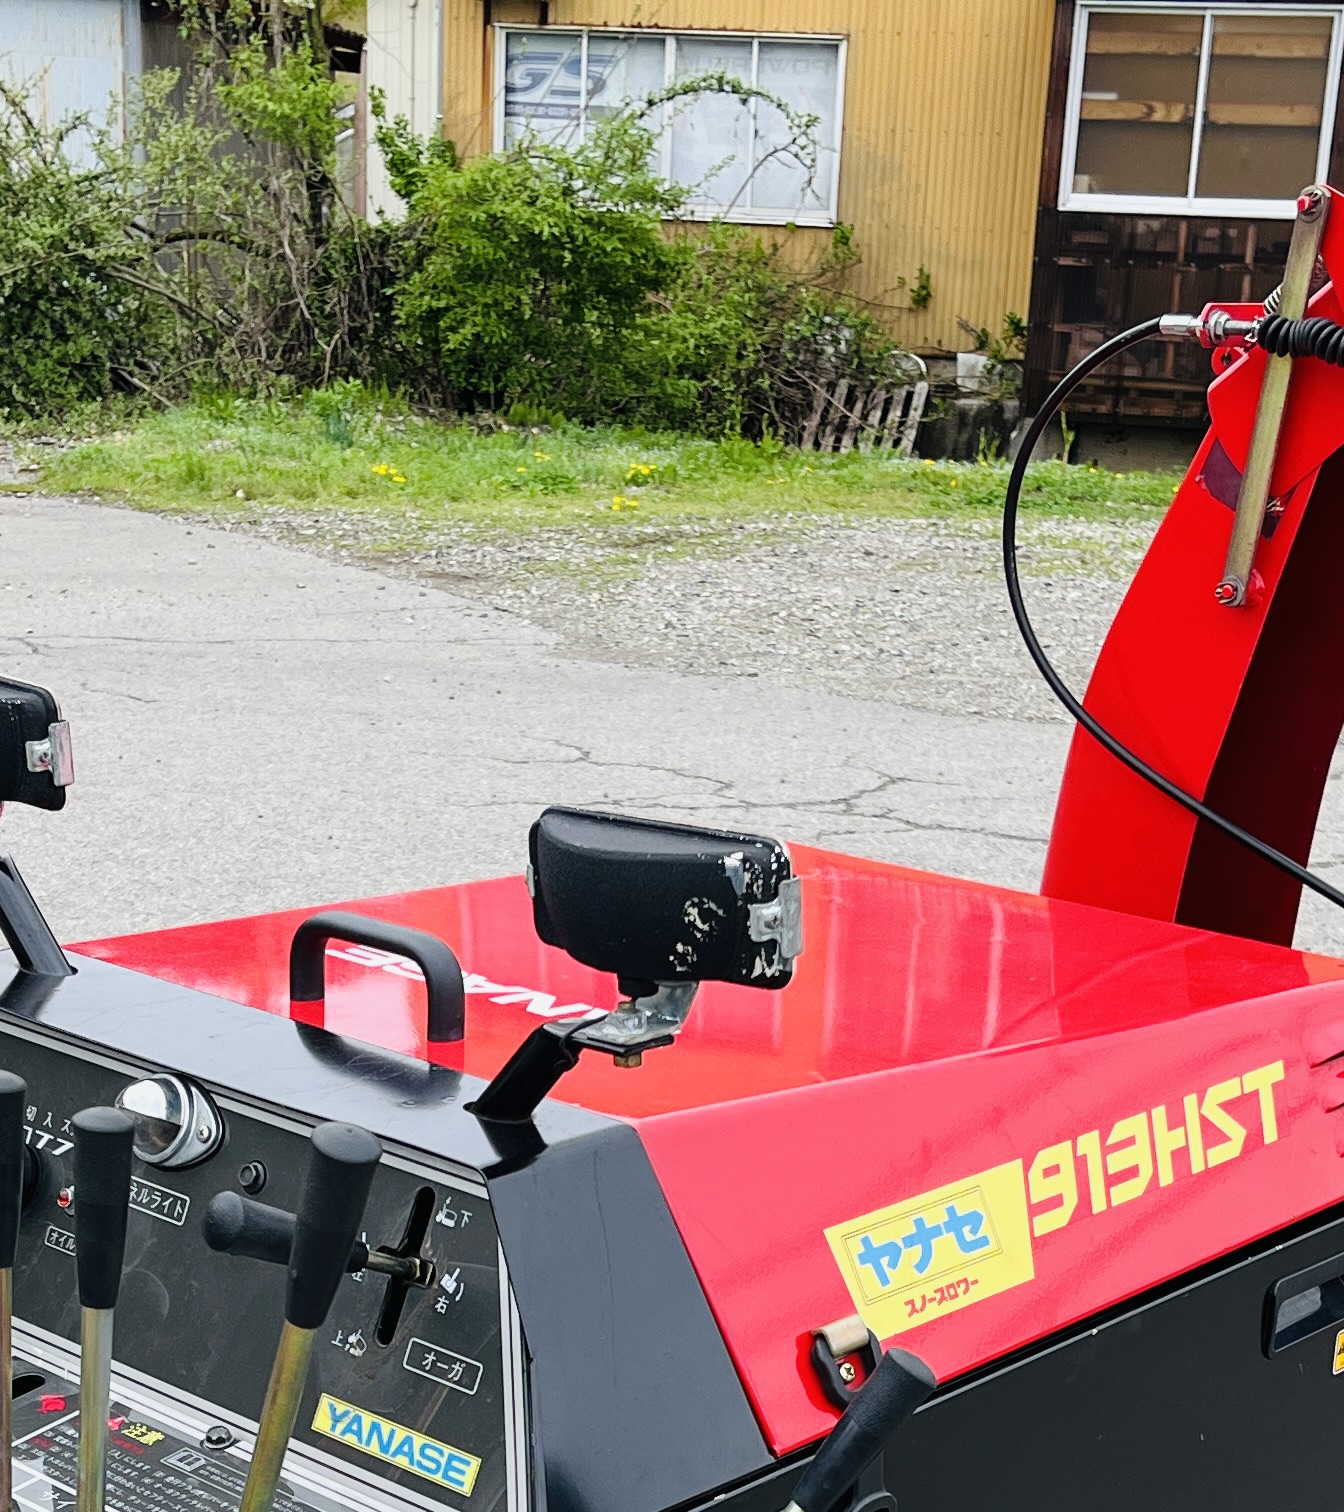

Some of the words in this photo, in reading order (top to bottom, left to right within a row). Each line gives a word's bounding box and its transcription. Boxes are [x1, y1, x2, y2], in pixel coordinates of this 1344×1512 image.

[25, 1105, 38, 1122] 切
[43, 1111, 53, 1129] 入
[1028, 1060, 1285, 1238] 913HST
[129, 1182, 183, 1219] ネルライト
[460, 1209, 473, 1228] 下
[50, 1231, 77, 1250] オイル
[856, 1204, 991, 1289] ヤナセ
[434, 1295, 450, 1315] 右
[904, 1277, 979, 1318] スノースロワー
[330, 1329, 344, 1347] 上
[421, 1351, 467, 1381] オーガ
[327, 1401, 472, 1488] YANASE
